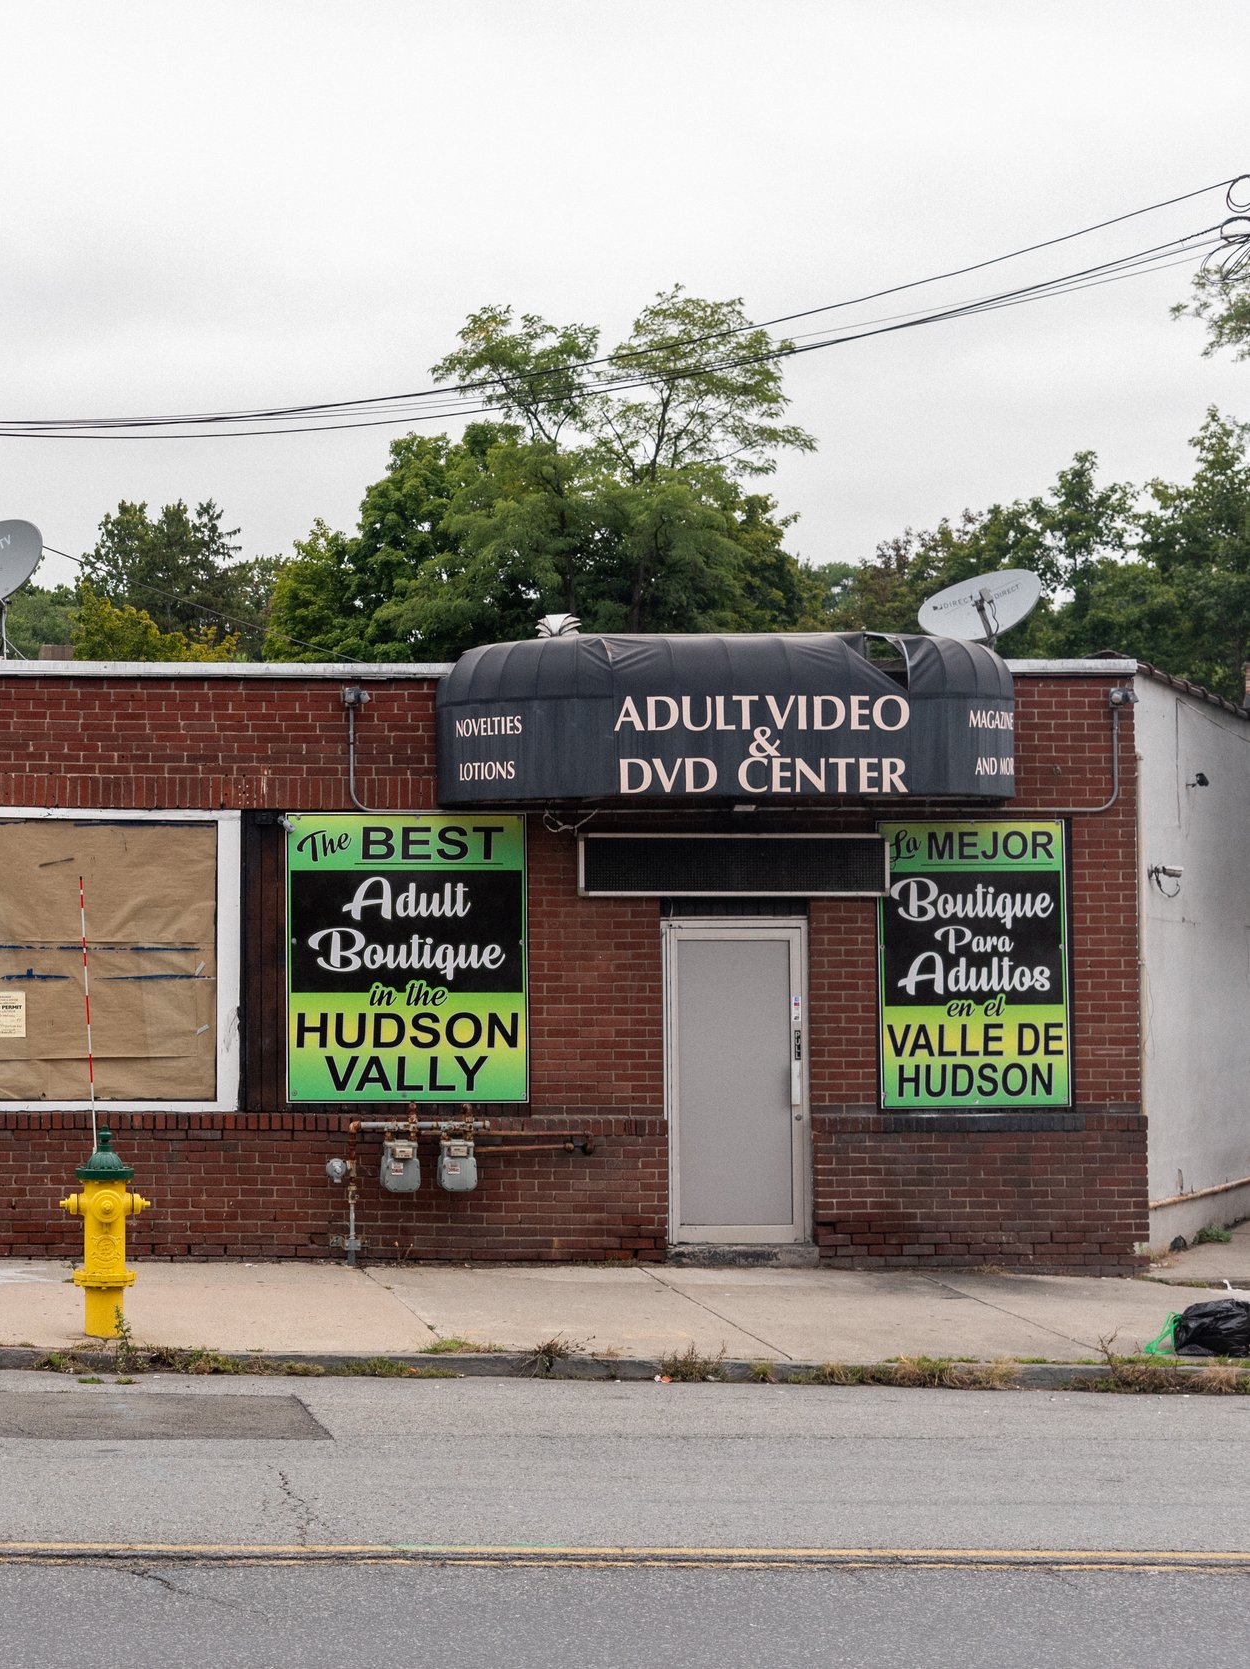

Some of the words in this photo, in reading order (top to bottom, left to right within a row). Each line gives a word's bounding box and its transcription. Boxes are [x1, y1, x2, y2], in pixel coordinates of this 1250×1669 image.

[455, 715, 523, 738] NOVELTIES
[613, 695, 759, 731] ADULT
[765, 694, 910, 731] VIDEO
[748, 726, 781, 757] &
[459, 761, 516, 781] LOTIONS
[619, 758, 718, 793] DVD
[737, 757, 909, 793] CENTER
[974, 756, 998, 776] AND
[296, 829, 352, 862] The
[361, 826, 504, 861] BEST
[889, 829, 922, 866] La
[927, 831, 1055, 861] MEJOR
[342, 876, 471, 921] Adult
[890, 877, 1054, 929] Boutique
[307, 927, 506, 981] Boutique
[934, 925, 1014, 954] Para
[897, 951, 1051, 996] Adultos
[369, 983, 398, 1007] in
[405, 981, 448, 1007] the
[946, 1000, 975, 1018] en
[983, 994, 1006, 1018] el
[296, 1012, 519, 1049] HUDSON
[887, 1023, 1004, 1058] VALLE
[1017, 1022, 1065, 1057] DE
[325, 1055, 489, 1092] VALLY
[897, 1063, 1053, 1098] HUDSON
